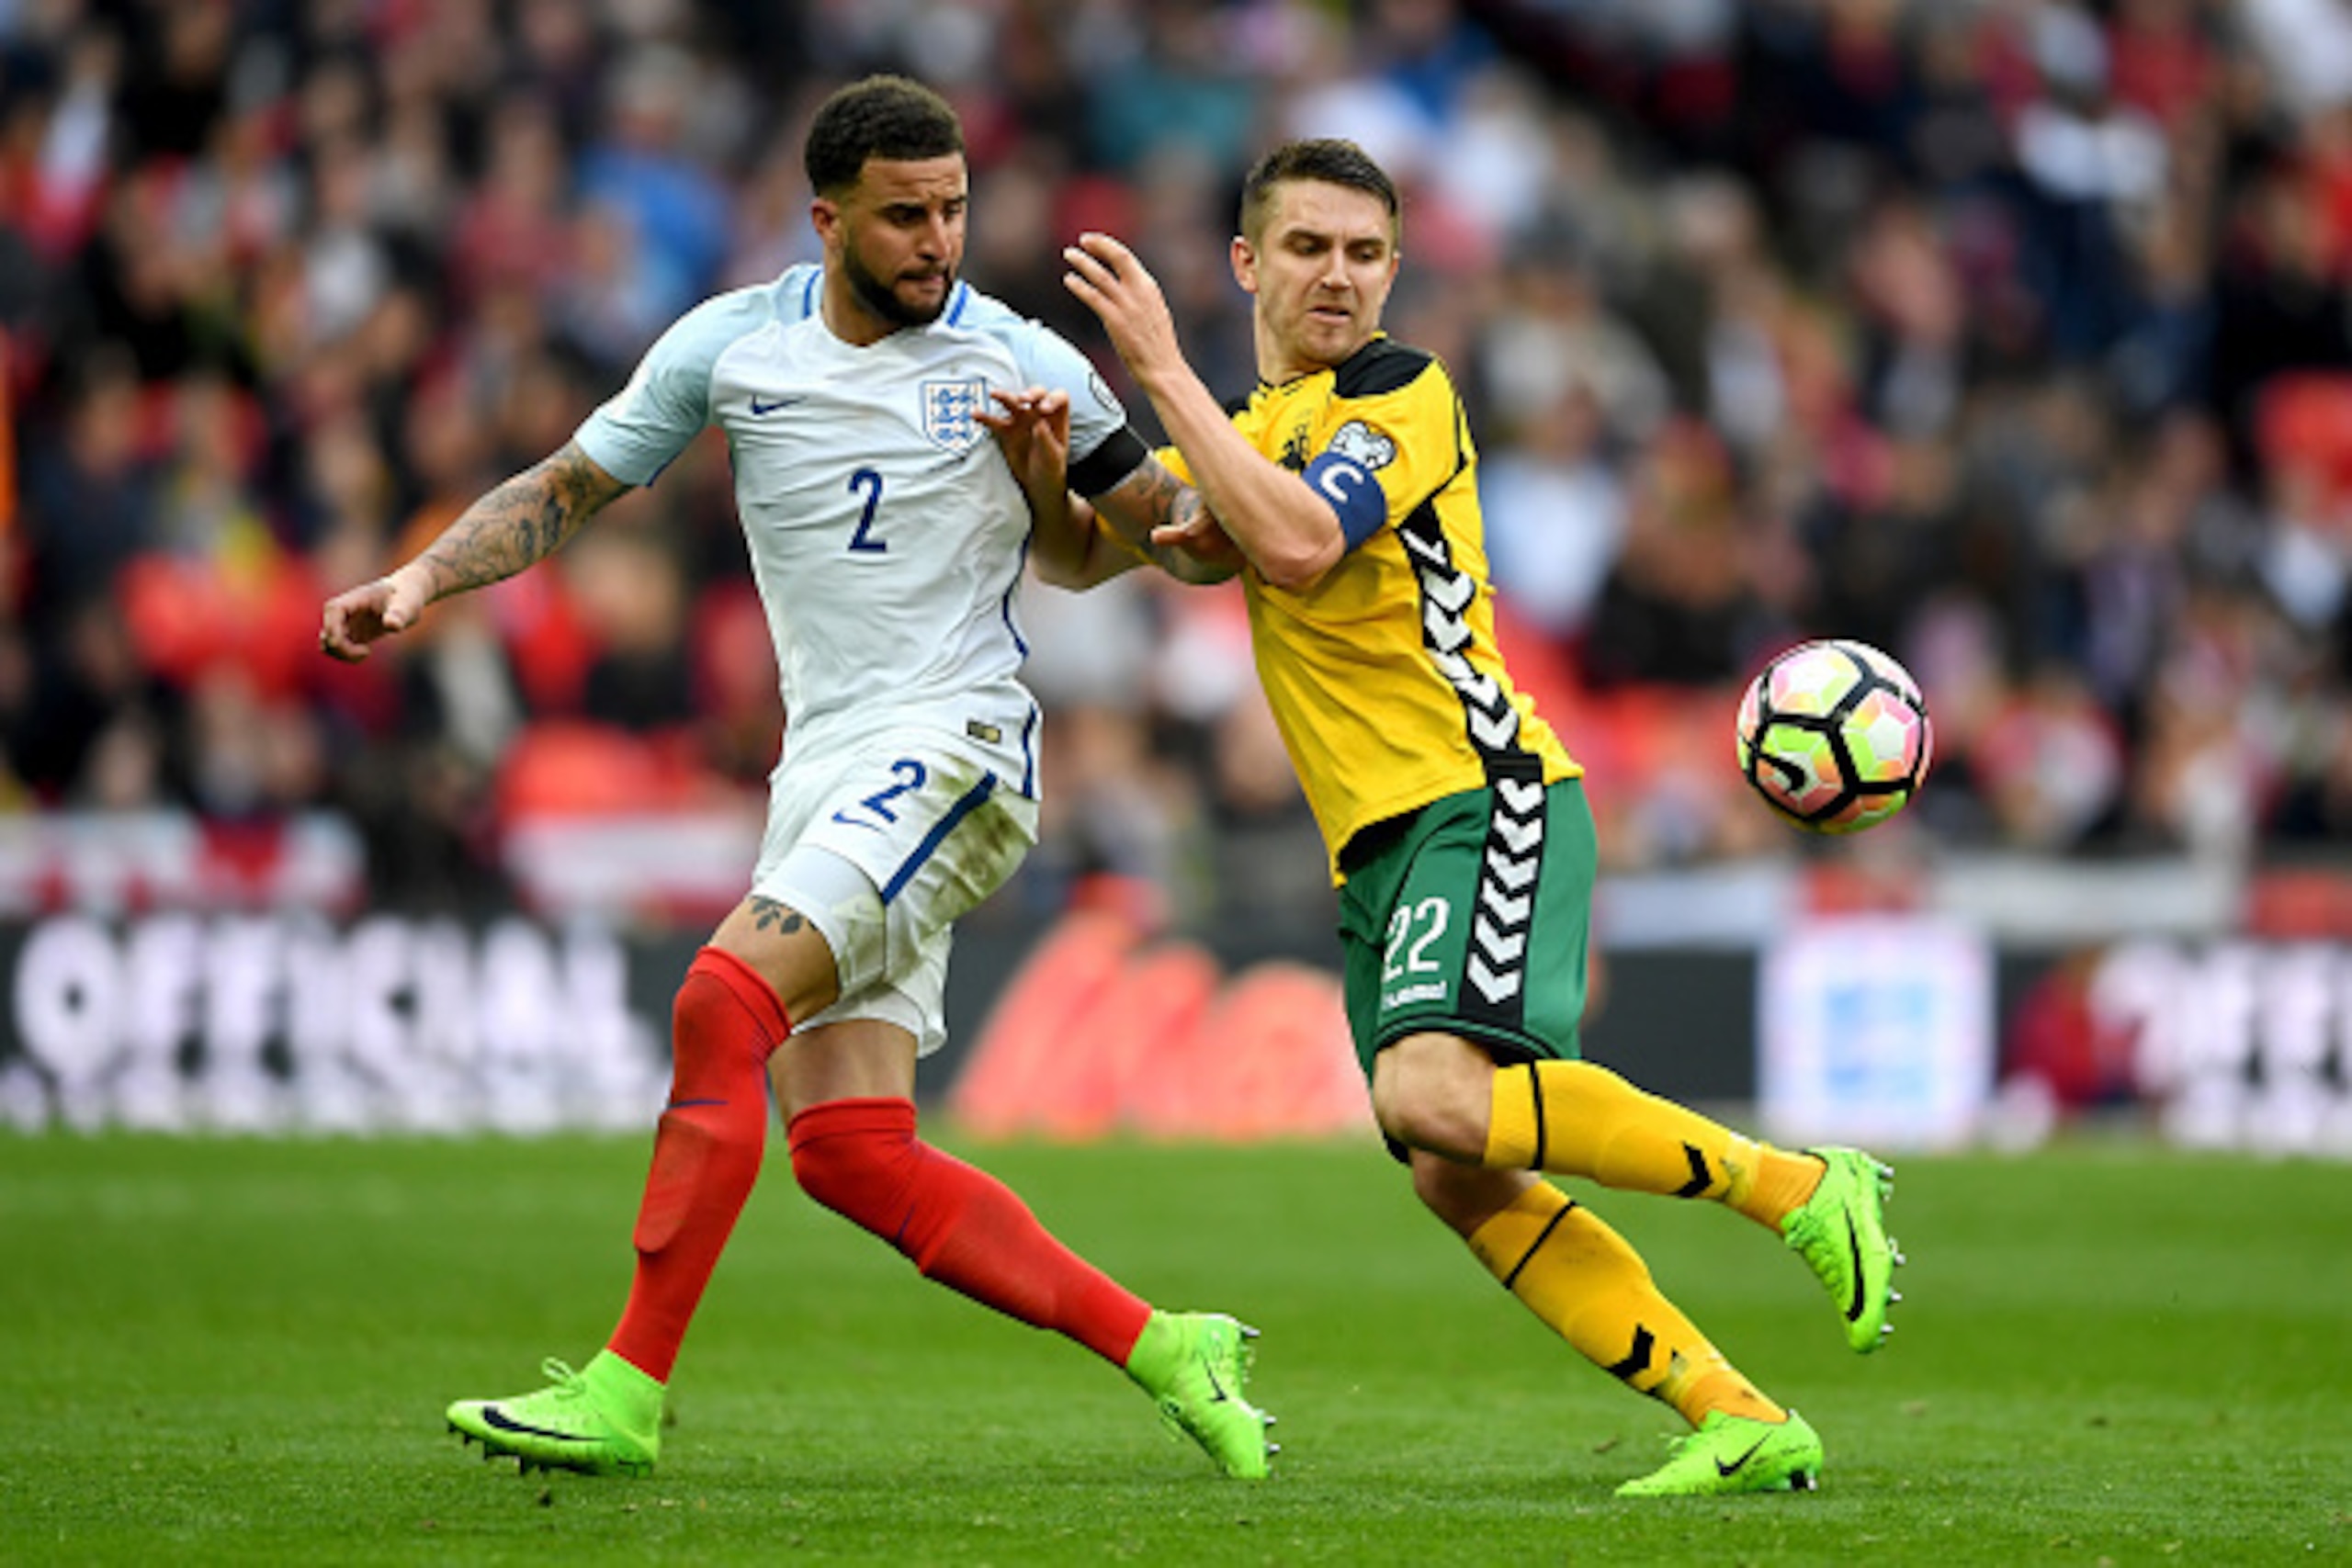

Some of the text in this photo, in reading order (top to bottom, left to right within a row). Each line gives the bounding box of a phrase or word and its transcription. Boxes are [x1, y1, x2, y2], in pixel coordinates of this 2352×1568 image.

[847, 467, 888, 552] 2
[1319, 462, 1364, 502] C
[860, 758, 927, 823] 2
[1383, 897, 1450, 982] 22
